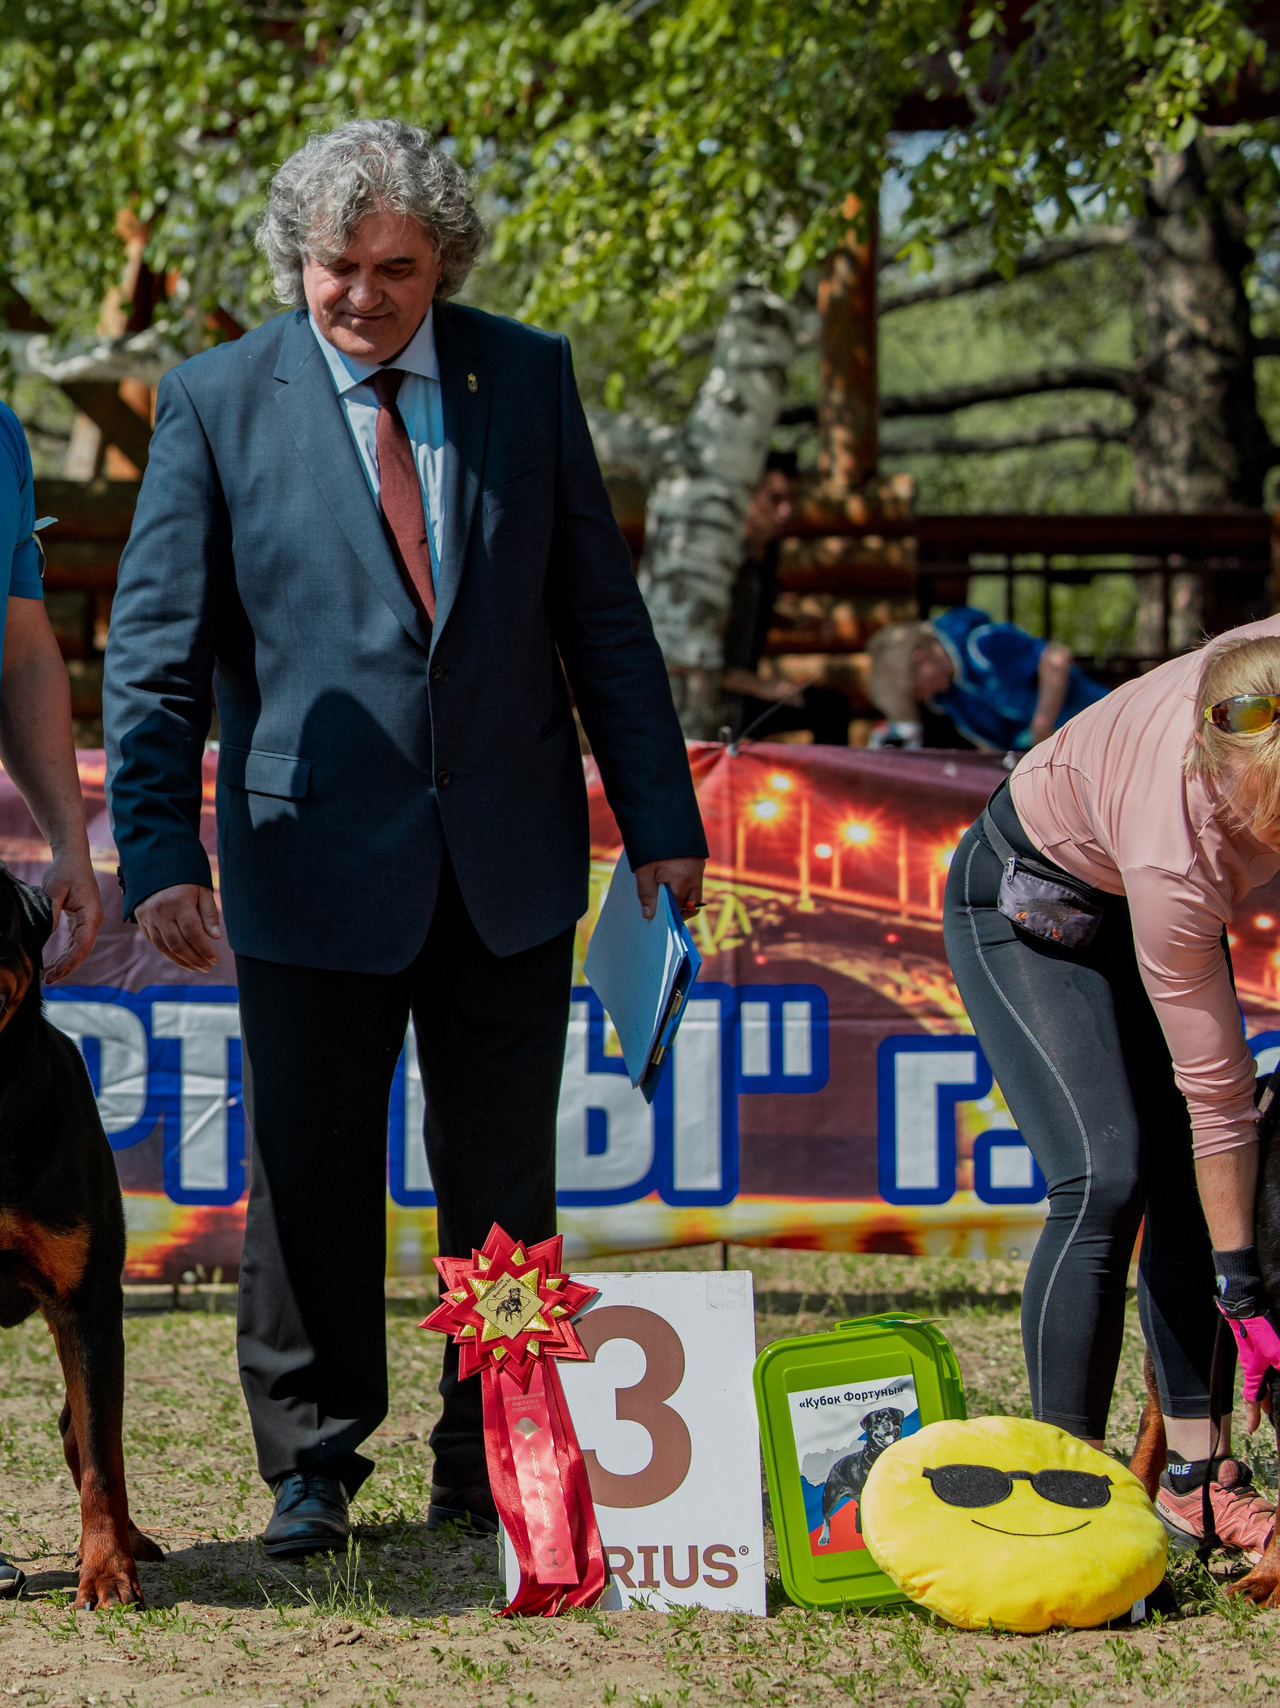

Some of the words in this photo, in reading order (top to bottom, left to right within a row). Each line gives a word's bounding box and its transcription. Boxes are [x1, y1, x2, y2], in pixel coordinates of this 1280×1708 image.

[557, 1305, 692, 1509] 3
[799, 1396, 841, 1409] «Кубок
[843, 1387, 904, 1402] Фортуны»
